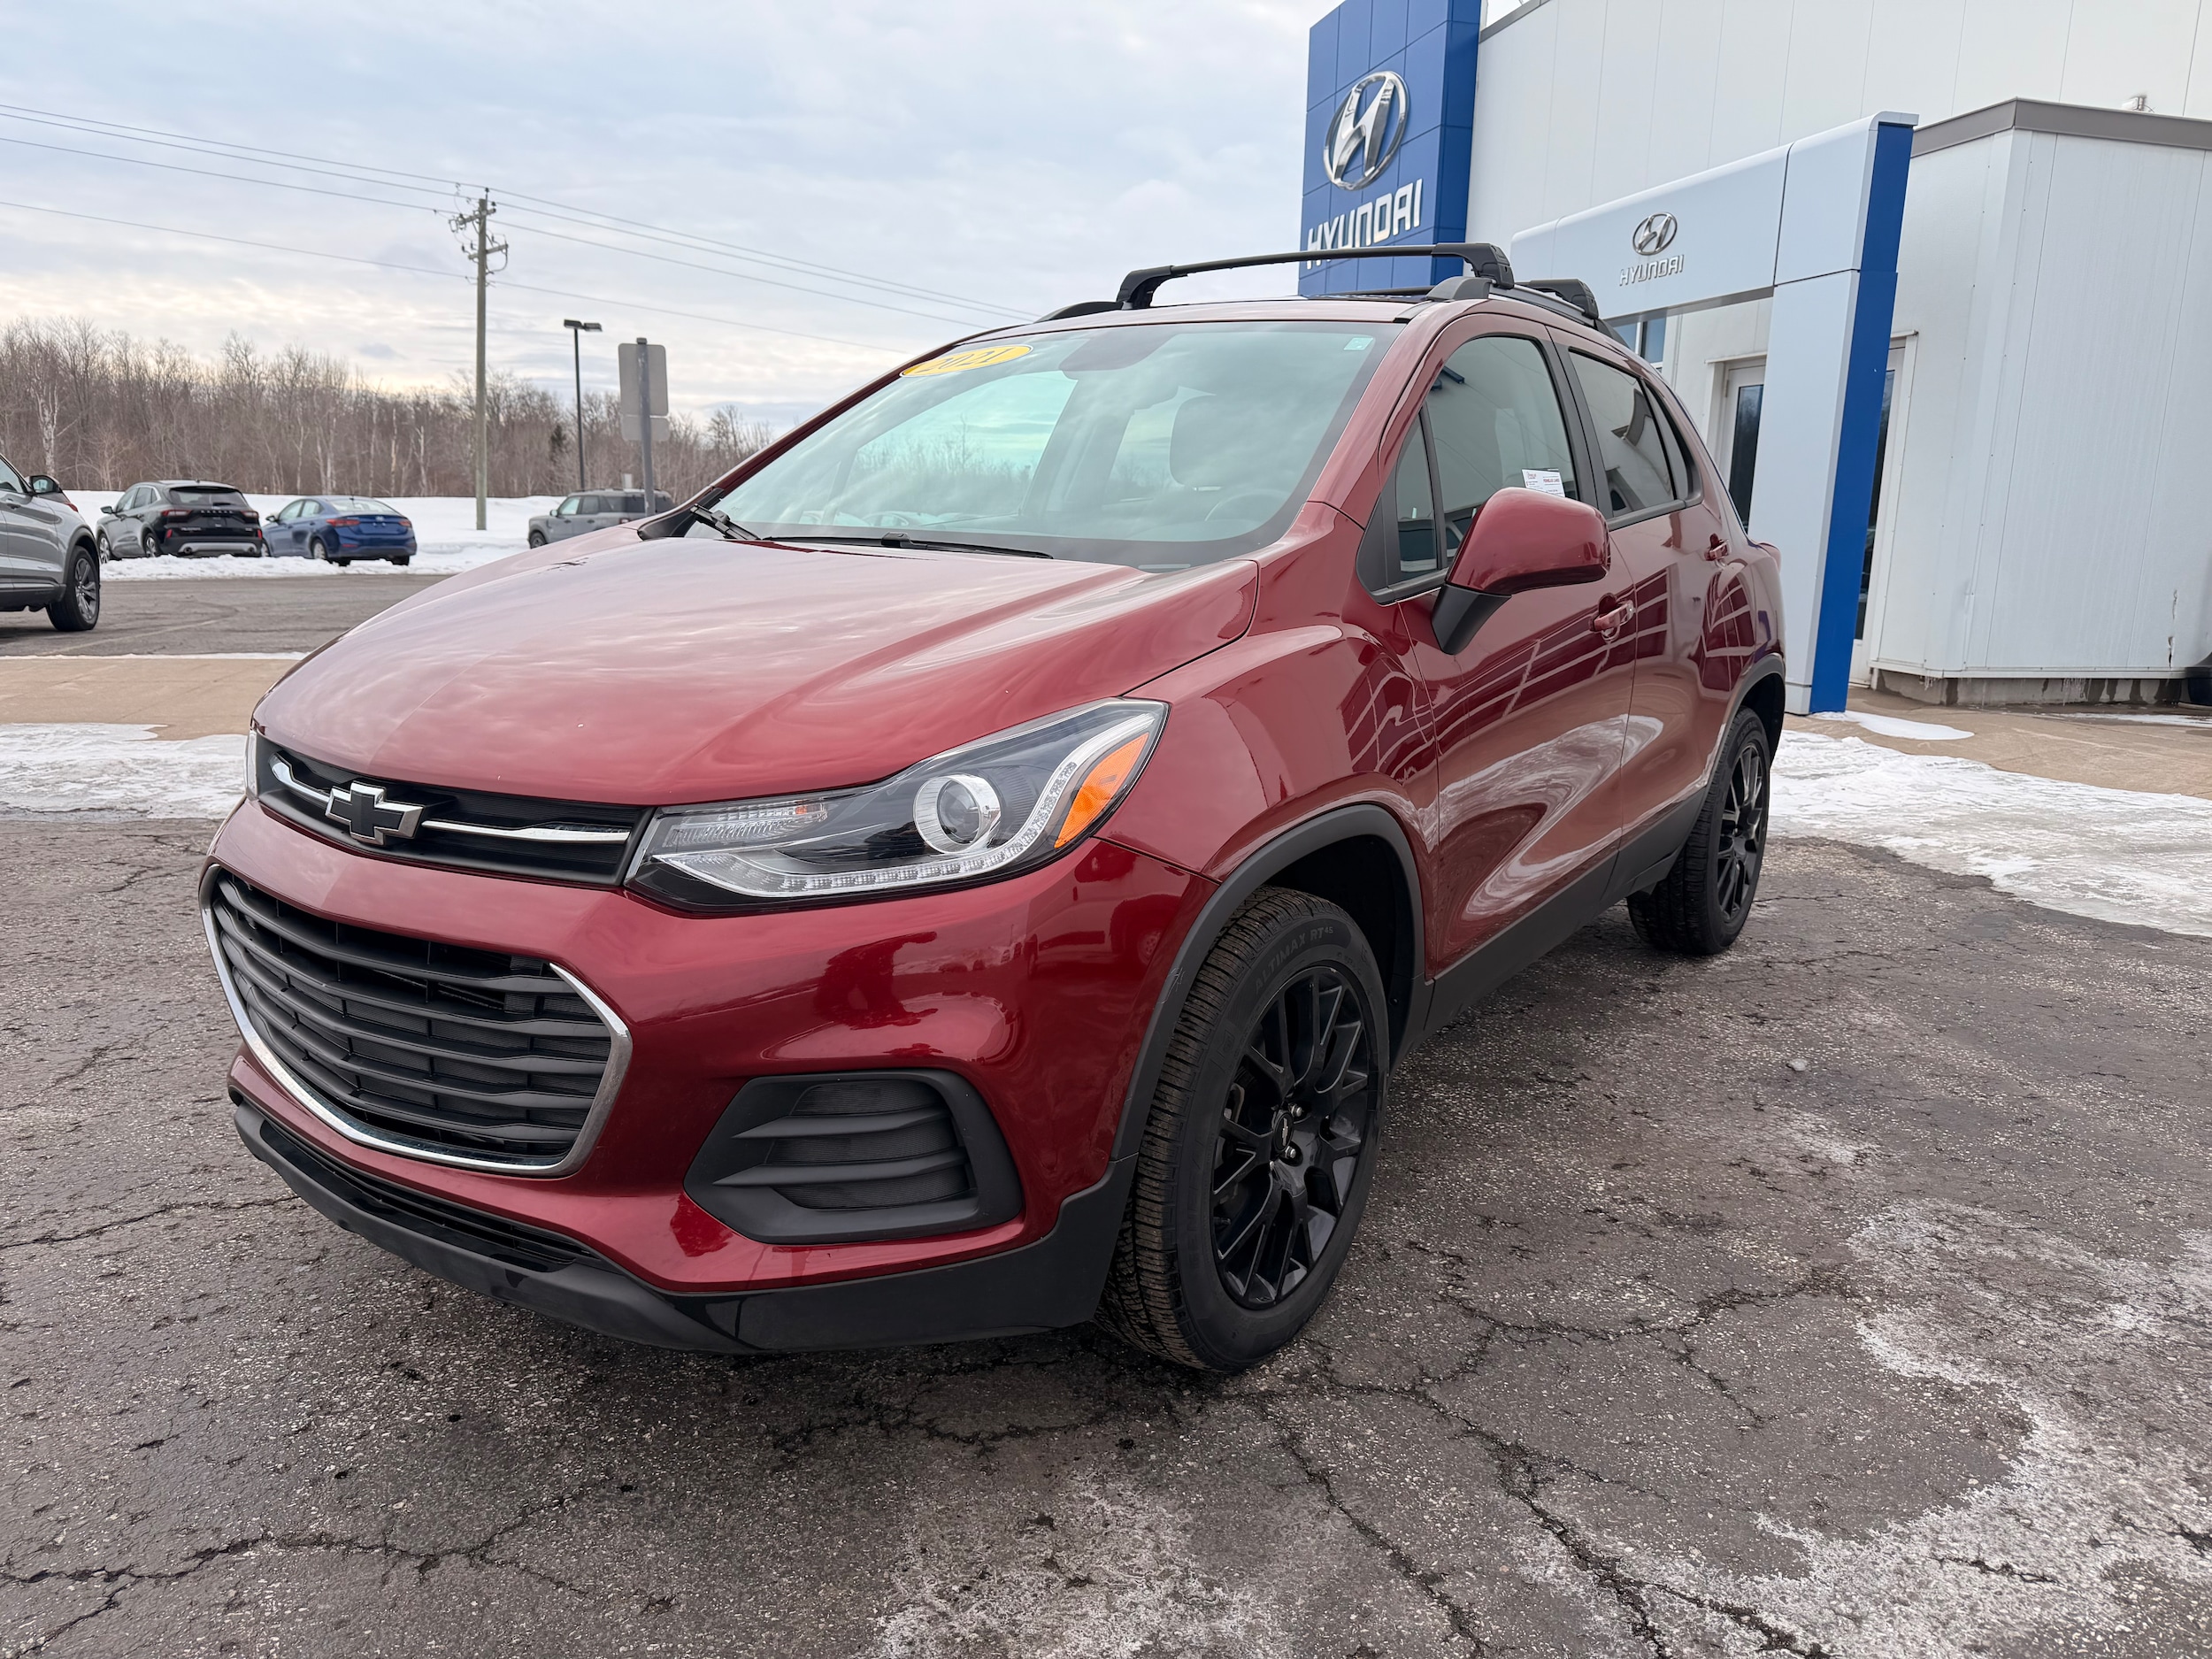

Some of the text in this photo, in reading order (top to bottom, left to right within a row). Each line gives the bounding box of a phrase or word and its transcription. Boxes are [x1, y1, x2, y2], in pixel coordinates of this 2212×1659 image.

[1306, 179, 1423, 270] HYUNDAI
[1619, 254, 1685, 287] HYUNDAI
[1255, 933, 1306, 995] ALTIMAX
